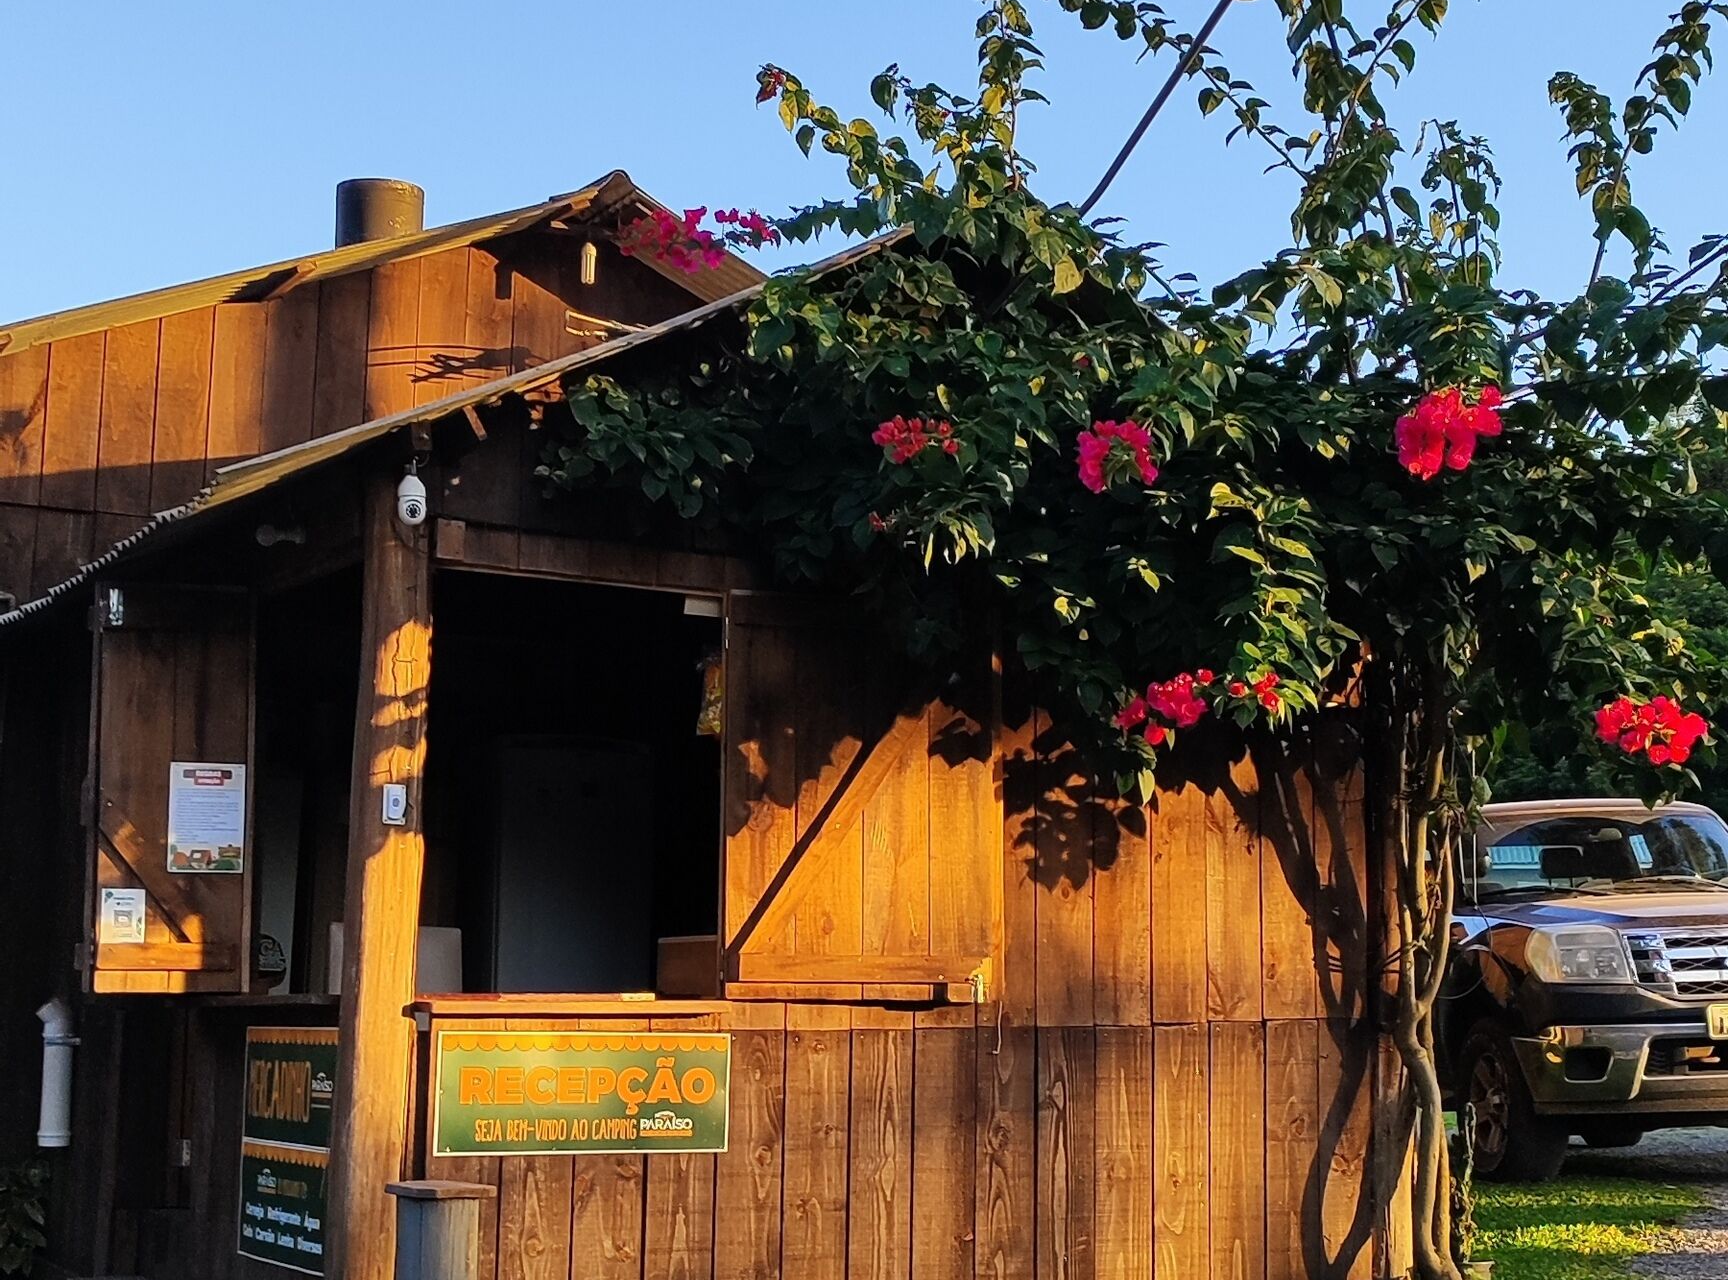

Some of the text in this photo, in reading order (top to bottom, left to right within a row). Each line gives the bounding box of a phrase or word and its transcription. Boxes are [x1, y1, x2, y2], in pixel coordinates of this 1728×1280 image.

[459, 1057, 715, 1115] RECEPÇÃO
[475, 1118, 637, 1142] SEJA BEM-VINDO AO CAMPING
